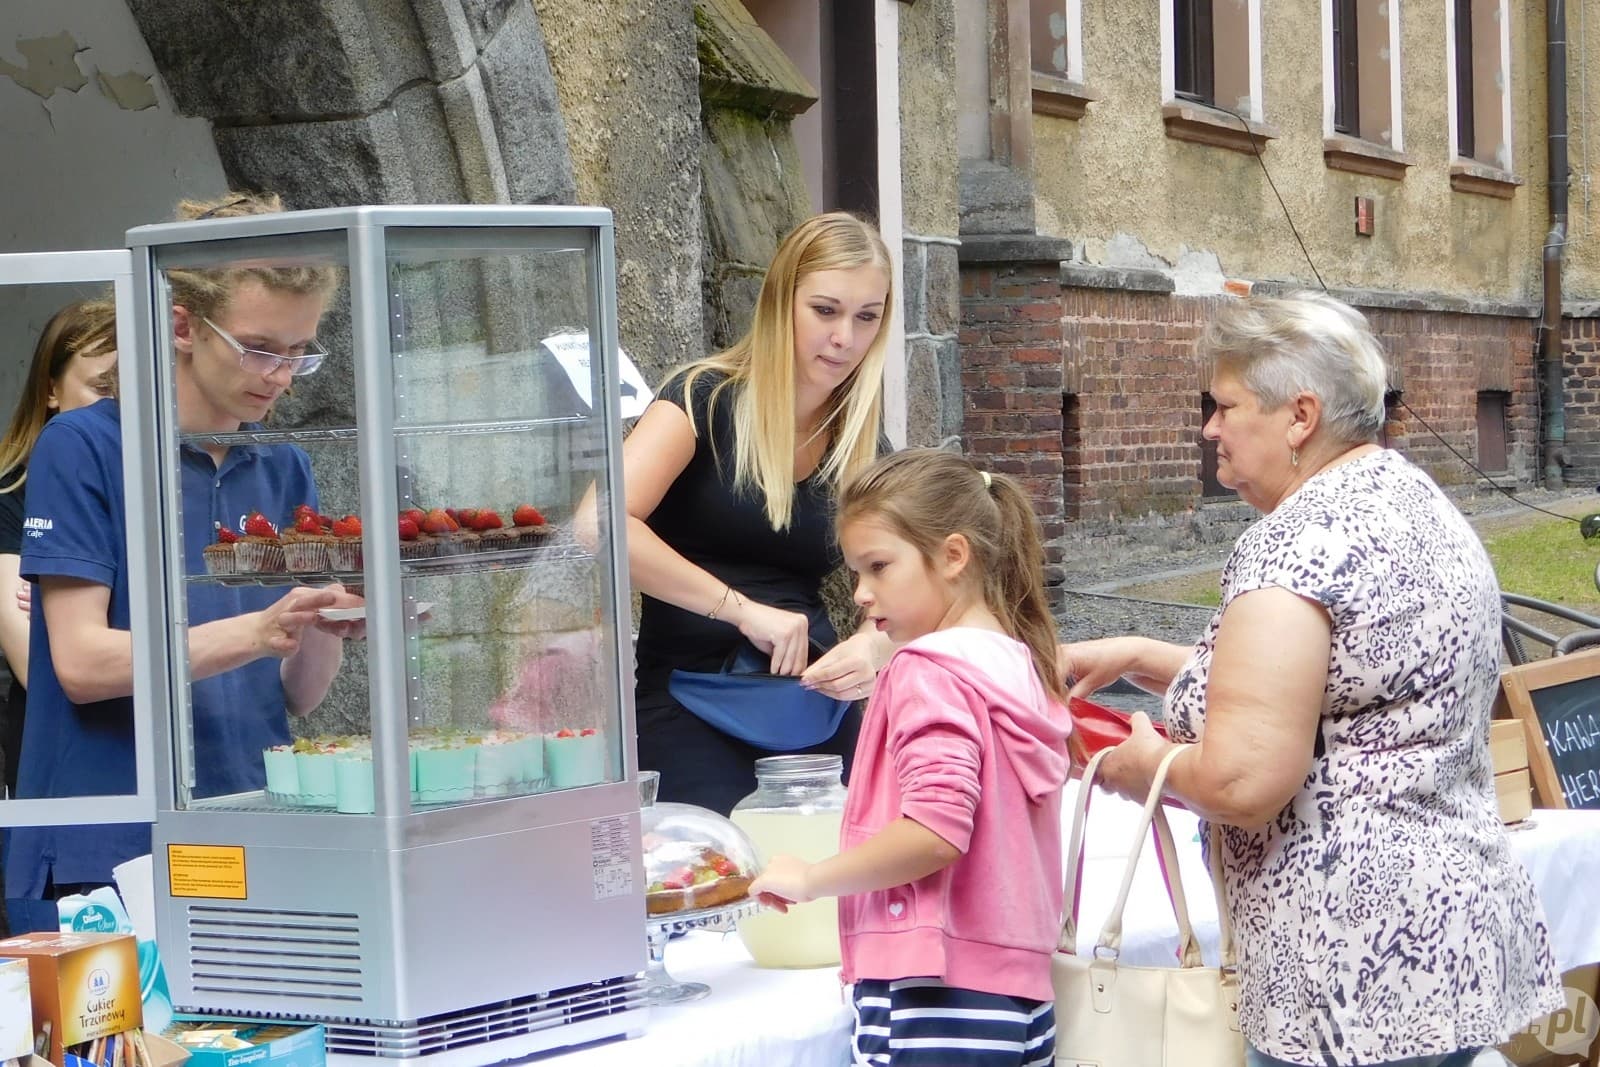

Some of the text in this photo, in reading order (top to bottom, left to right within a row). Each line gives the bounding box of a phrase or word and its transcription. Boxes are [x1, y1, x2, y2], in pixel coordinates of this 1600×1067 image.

[23, 517, 53, 530] ALERIA
[1546, 715, 1600, 757] KAWA
[1561, 769, 1600, 808] HER
[87, 999, 115, 1013] Cukier
[79, 1009, 125, 1028] Trzcinowy
